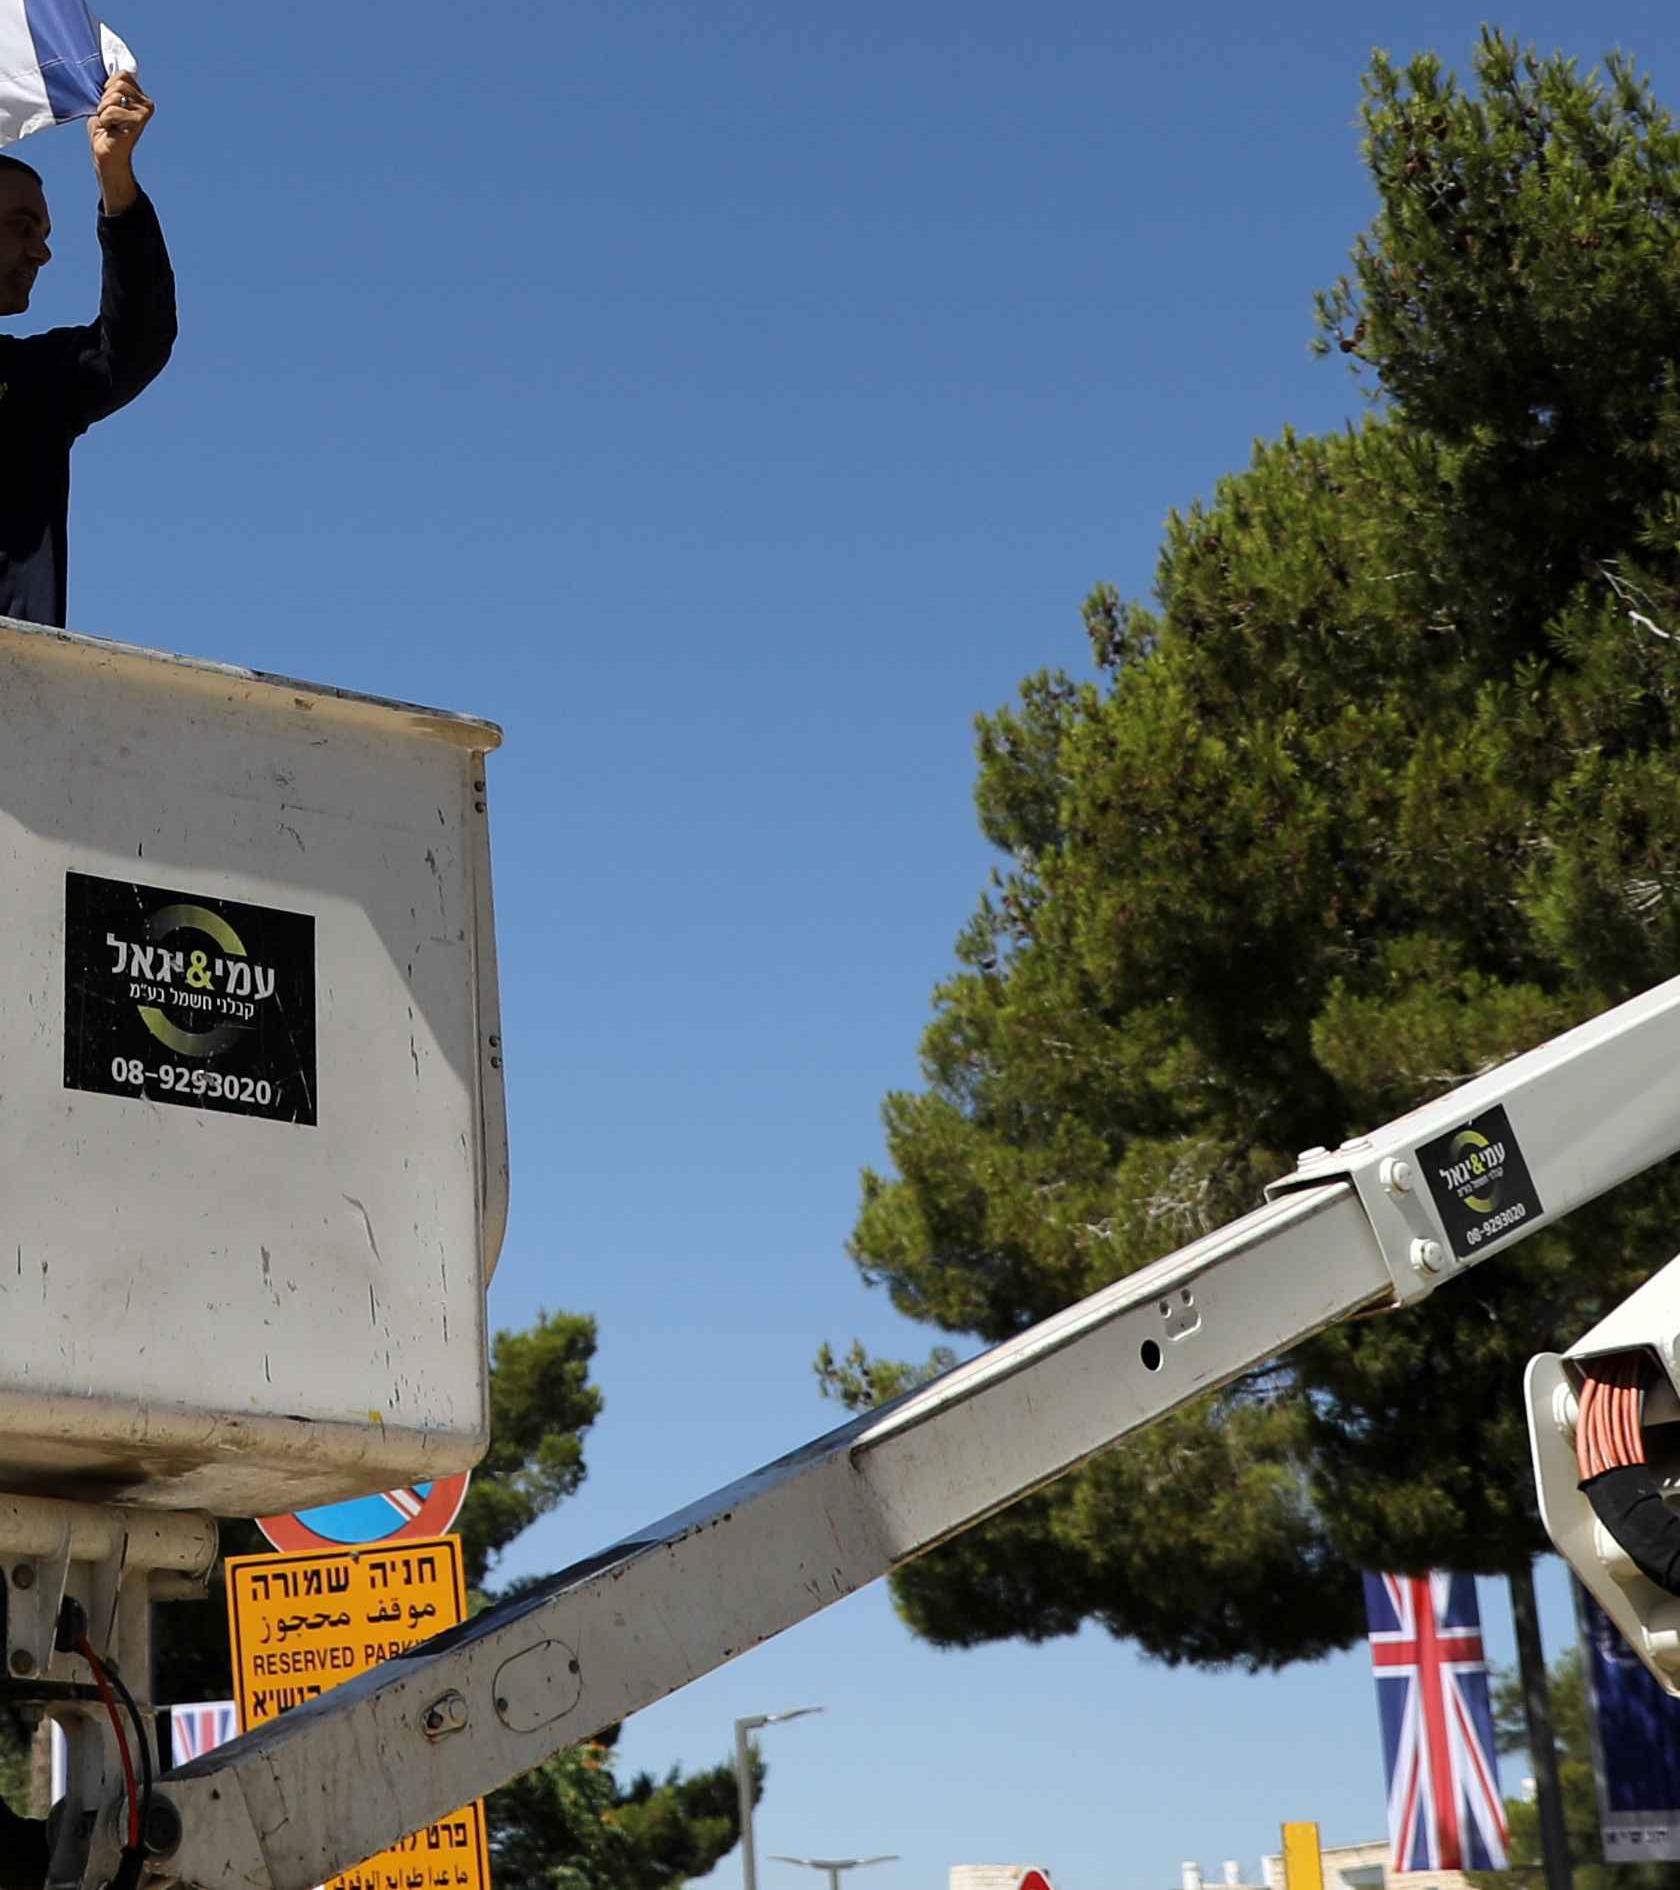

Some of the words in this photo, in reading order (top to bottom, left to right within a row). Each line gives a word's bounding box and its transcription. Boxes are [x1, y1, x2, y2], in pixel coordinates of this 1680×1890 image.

[106, 932, 275, 1001] עמי&יגאל
[170, 988, 212, 1011] חשמל
[216, 999, 254, 1020] קבלני
[111, 1056, 272, 1105] 08-9293020
[1439, 1141, 1506, 1190] עמי&יגאל
[1466, 1202, 1526, 1245] 08-9293020
[250, 1565, 350, 1601] שמורה
[368, 1556, 437, 1590] חניה
[260, 1610, 351, 1644] محجوز
[366, 1597, 437, 1629] موقف
[252, 1646, 355, 1677] RESERVED
